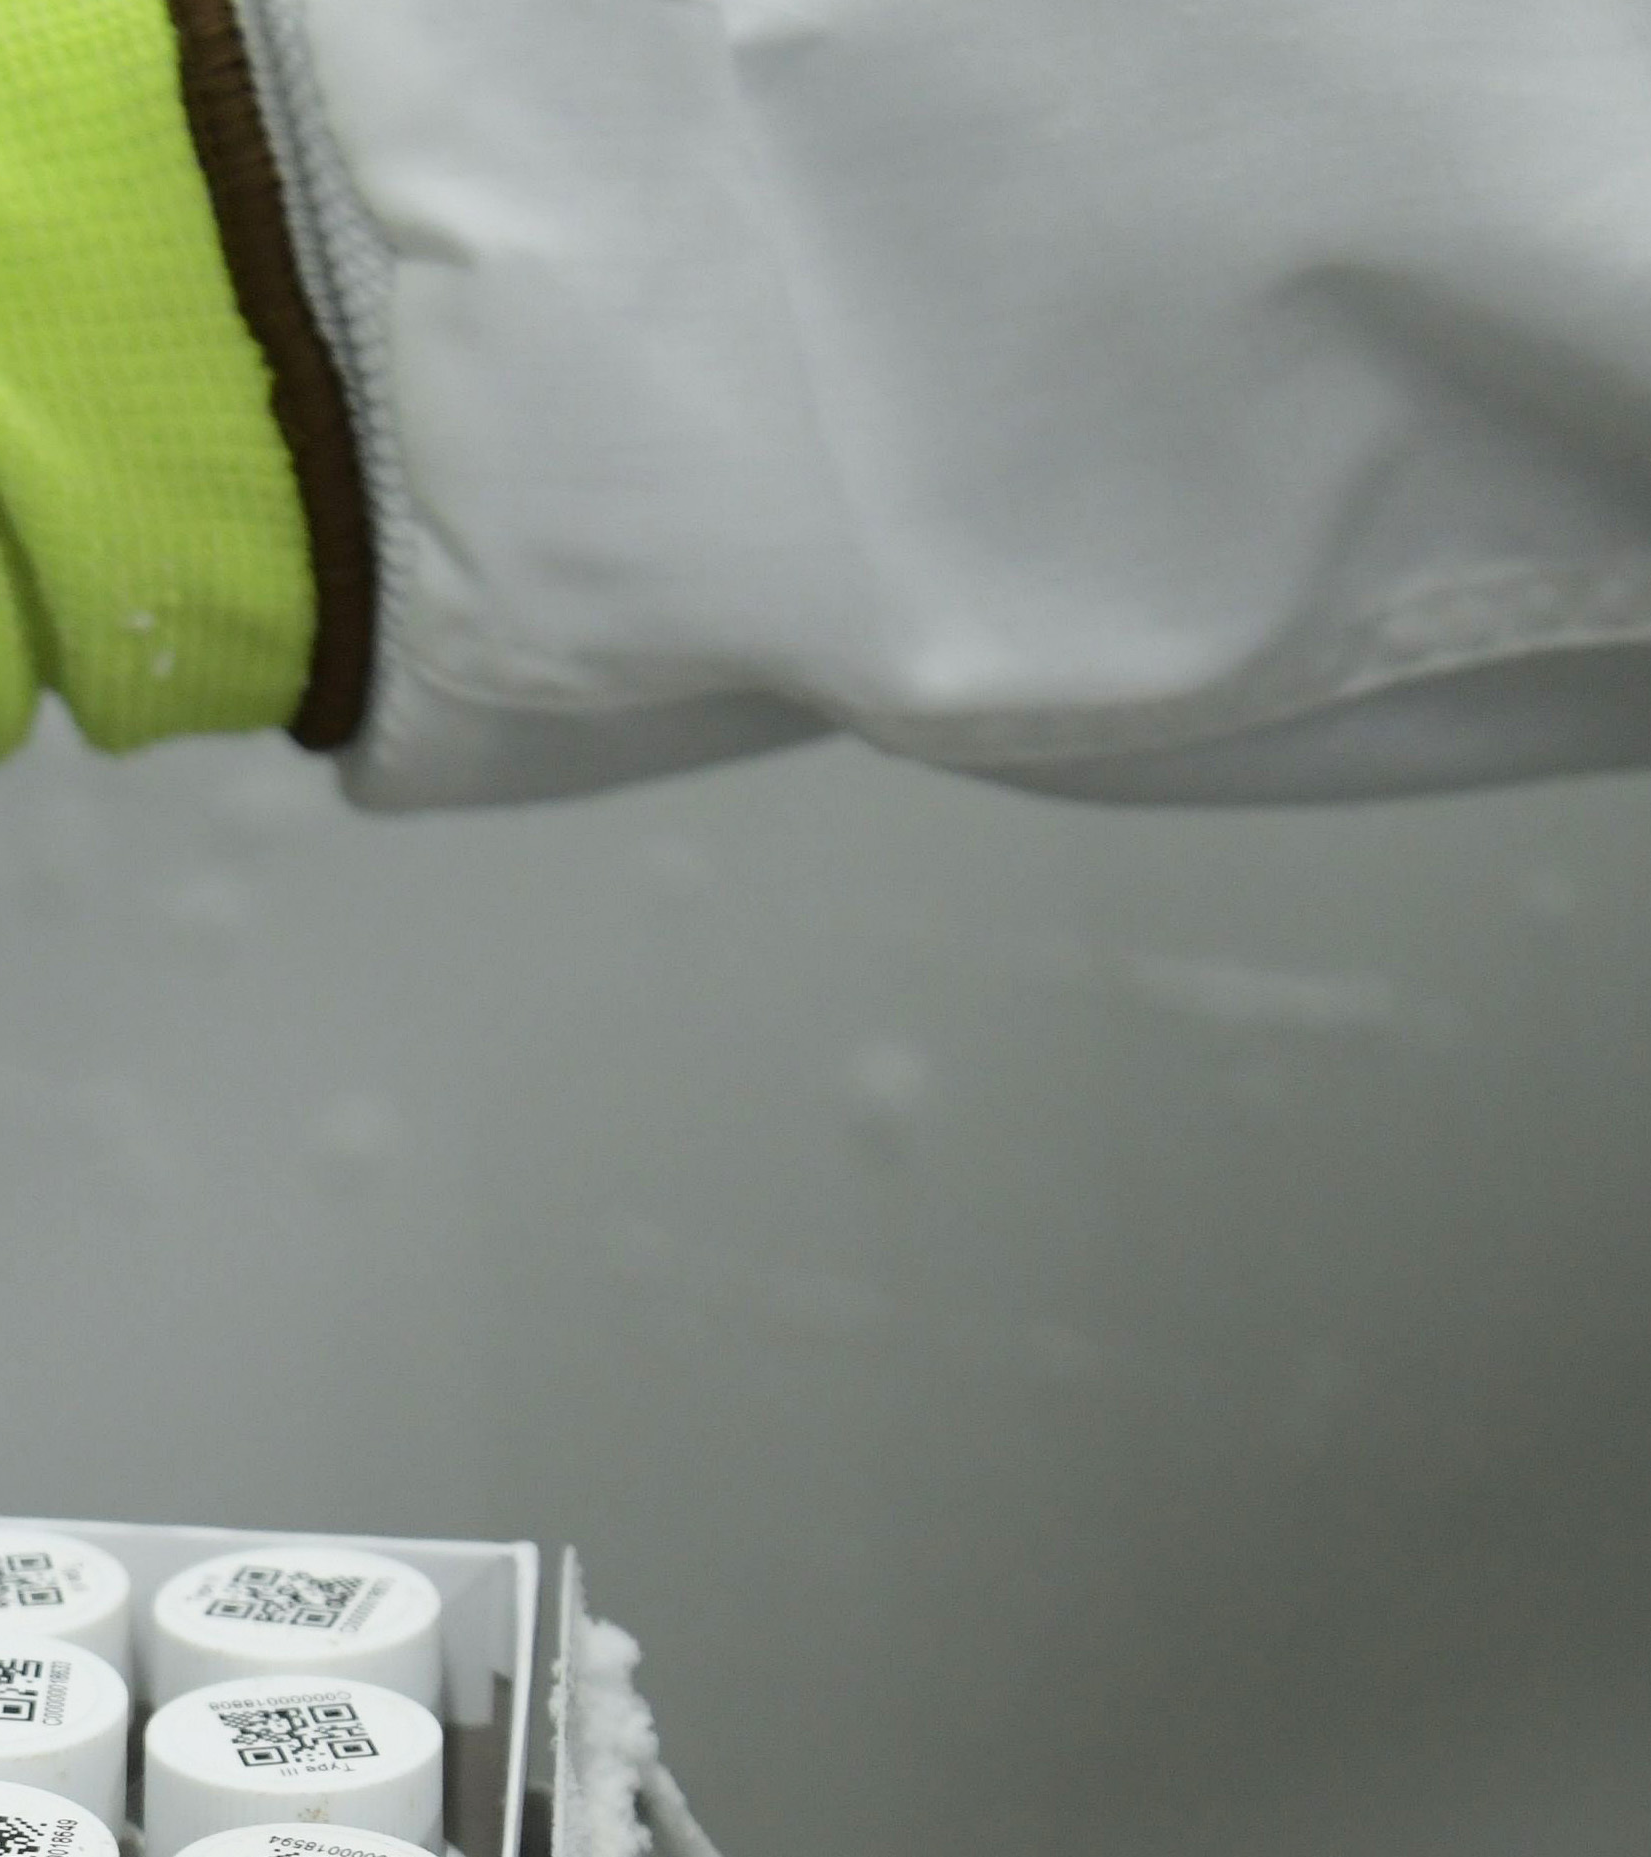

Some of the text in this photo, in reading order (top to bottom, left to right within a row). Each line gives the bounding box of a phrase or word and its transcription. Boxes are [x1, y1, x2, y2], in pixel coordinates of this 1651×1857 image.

[208, 1691, 351, 1711] C00000018808
[280, 1762, 355, 1776] Type III
